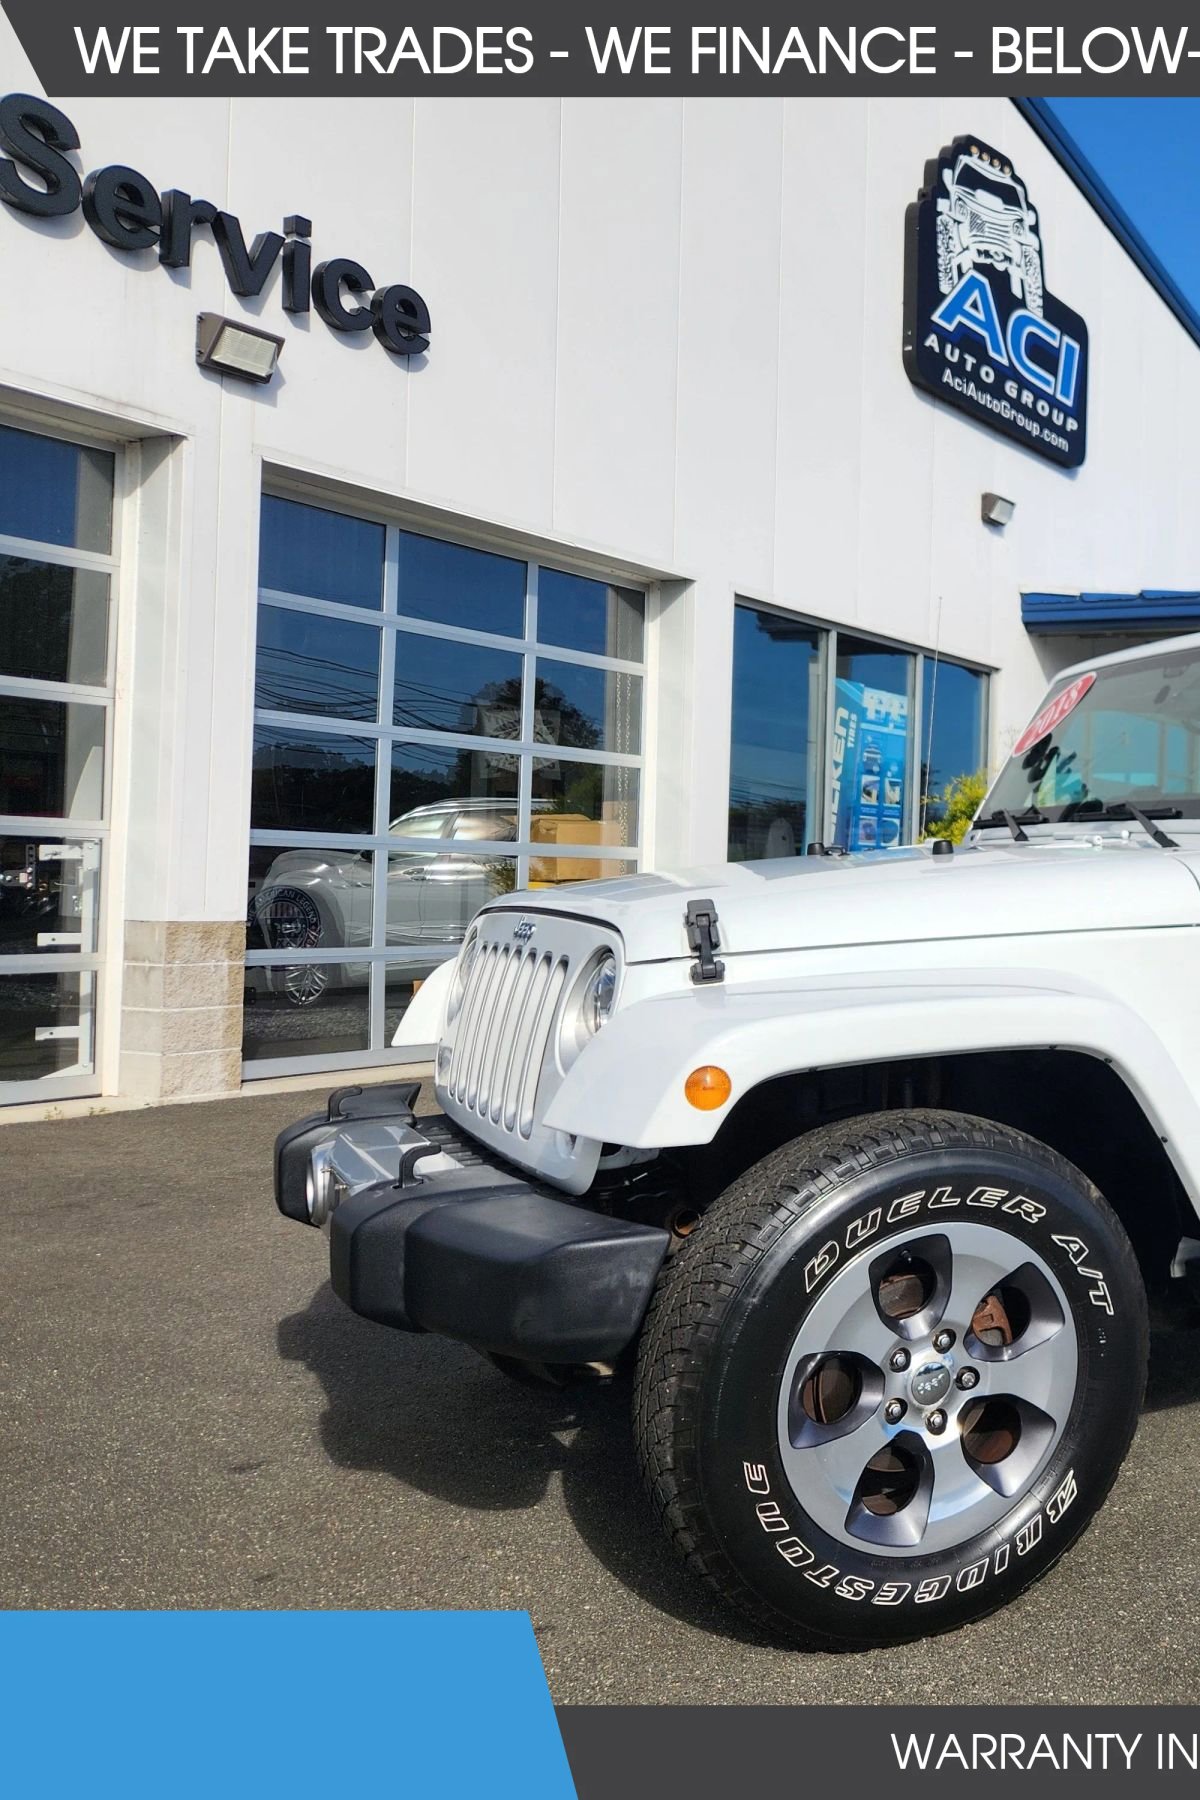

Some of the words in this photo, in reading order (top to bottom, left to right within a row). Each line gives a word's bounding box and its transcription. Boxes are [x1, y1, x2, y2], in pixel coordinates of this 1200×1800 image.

[0, 93, 431, 355] Service
[923, 333, 995, 384] AUTO
[1004, 380, 1078, 432] GROUP
[931, 269, 1080, 407] ACI
[942, 367, 1069, 452] AciAutoGroup.com
[803, 1186, 1047, 1293] DUELER
[1051, 1233, 1114, 1315] A/T
[743, 1461, 1077, 1606] BRIDGESTONE
